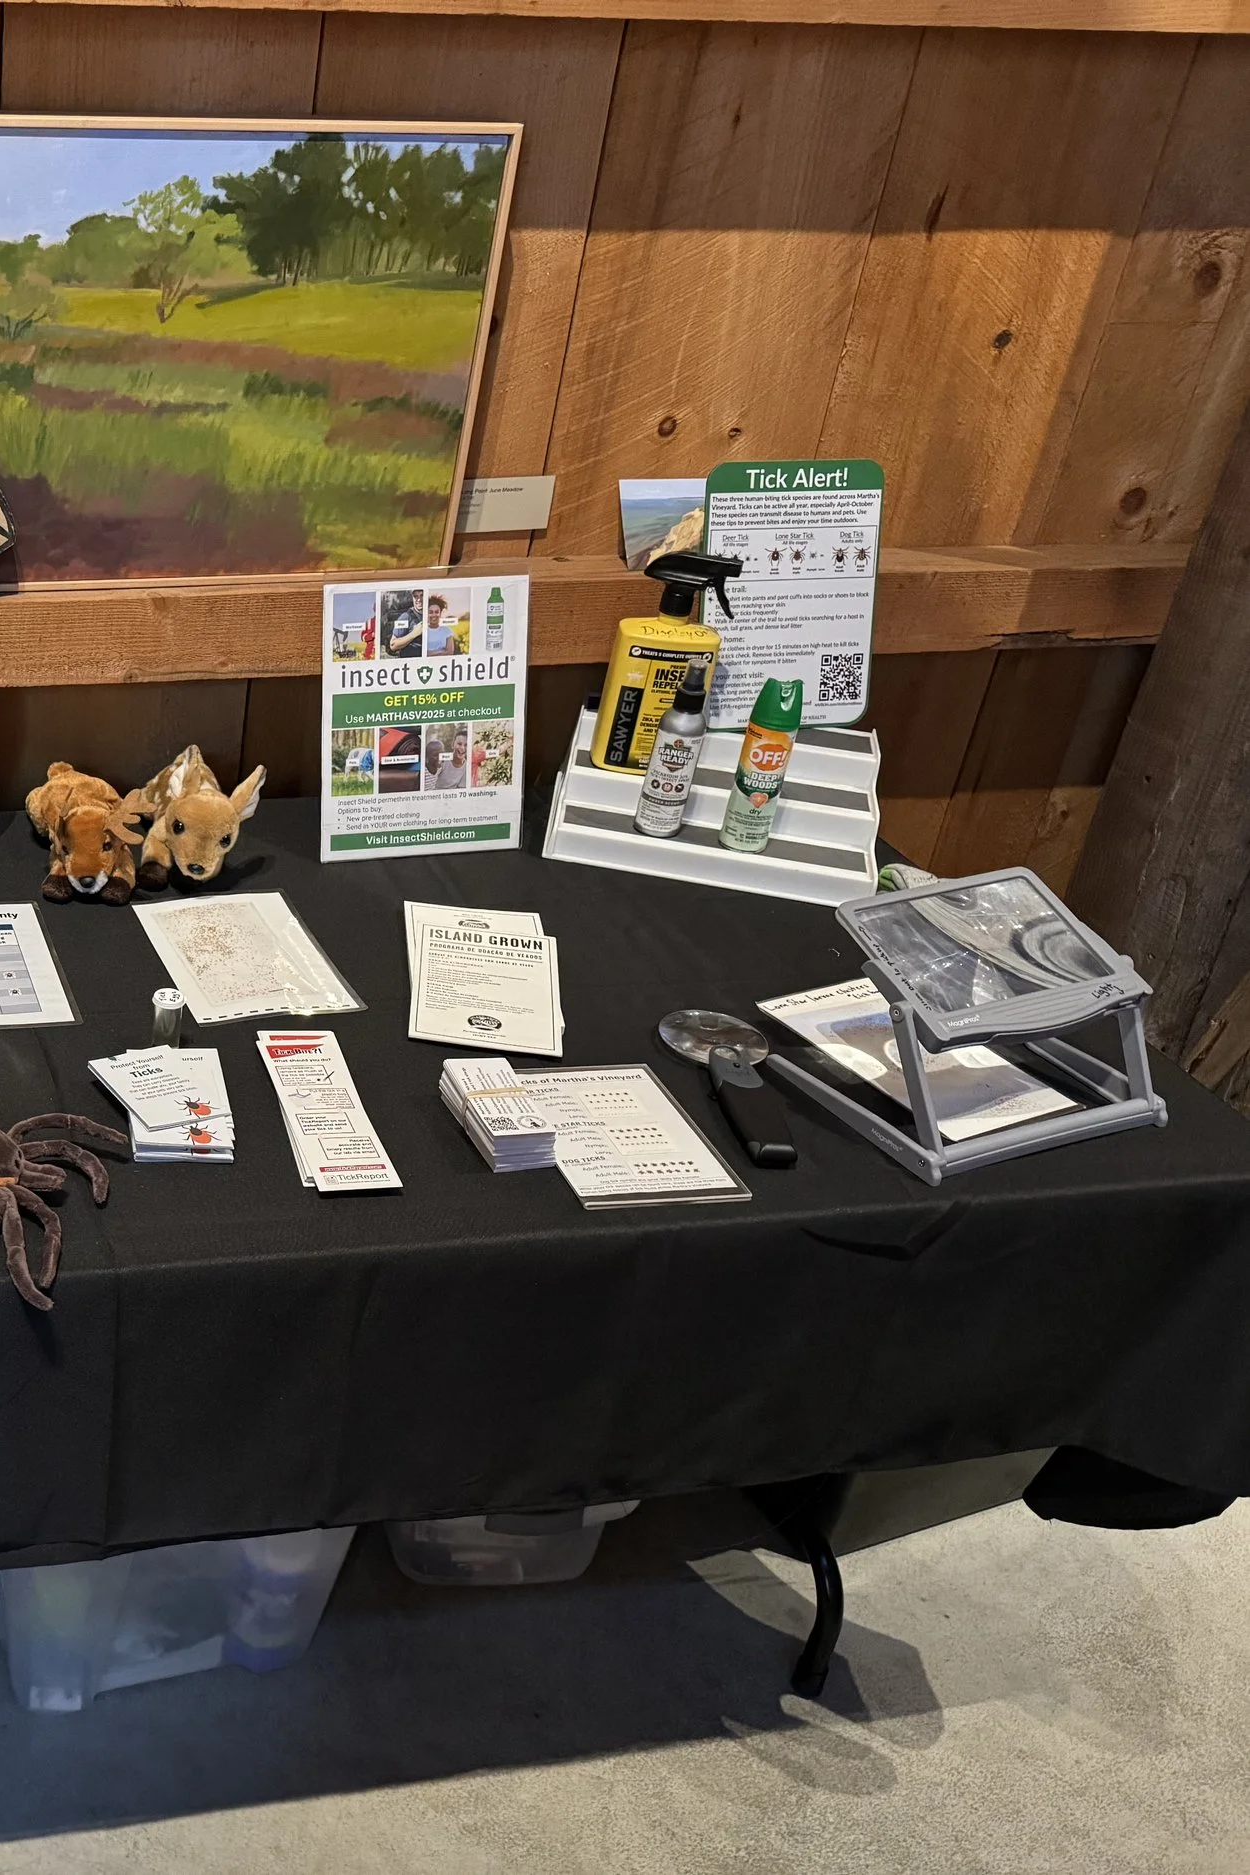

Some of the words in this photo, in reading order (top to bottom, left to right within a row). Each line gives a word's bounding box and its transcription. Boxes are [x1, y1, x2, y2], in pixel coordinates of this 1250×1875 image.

[746, 468, 788, 489] Tick
[792, 467, 849, 488] Alert!
[722, 534, 737, 542] Deer
[737, 533, 749, 541] Tick
[802, 532, 814, 540] Tick
[839, 531, 852, 539] Dog
[341, 662, 411, 688] insect
[438, 655, 510, 683] shield
[715, 673, 730, 681] your
[748, 671, 765, 679] visit:
[384, 694, 409, 707] GET
[411, 692, 437, 706] 15%
[439, 691, 465, 704] OFF
[345, 714, 365, 724] Use
[366, 709, 445, 723] MARTHASV2025
[447, 709, 457, 718] at
[458, 706, 501, 717] checkout
[609, 689, 638, 763] SAWYER
[658, 746, 694, 760] RANGER
[750, 748, 789, 766] OFF!
[660, 755, 690, 766] READY
[743, 776, 778, 789] WOODS
[751, 772, 777, 782] DEEP
[337, 799, 357, 807] Insect
[357, 797, 377, 806] Shield
[377, 795, 411, 805] permethrin
[411, 793, 442, 801] treatment
[442, 792, 458, 800] lasts
[459, 791, 467, 799] 70
[337, 807, 362, 815] Options
[361, 813, 395, 822] pre-treated
[395, 811, 421, 820] clothing
[749, 808, 762, 816] dry
[346, 823, 362, 831] Send
[370, 821, 388, 829] YOUR
[402, 818, 428, 828] clothing
[428, 817, 438, 825] for
[437, 815, 468, 825] long-term
[468, 814, 499, 823] treatment
[366, 836, 388, 845] Visit
[389, 829, 476, 844] InsectShield.com
[429, 928, 483, 943] ISLAND
[488, 935, 543, 951] GROWN
[110, 1061, 136, 1070] Protect
[136, 1054, 164, 1064] Yourself
[129, 1067, 164, 1078] Ticks
[552, 1076, 597, 1084] Martha's
[337, 1173, 389, 1182] TickReport
